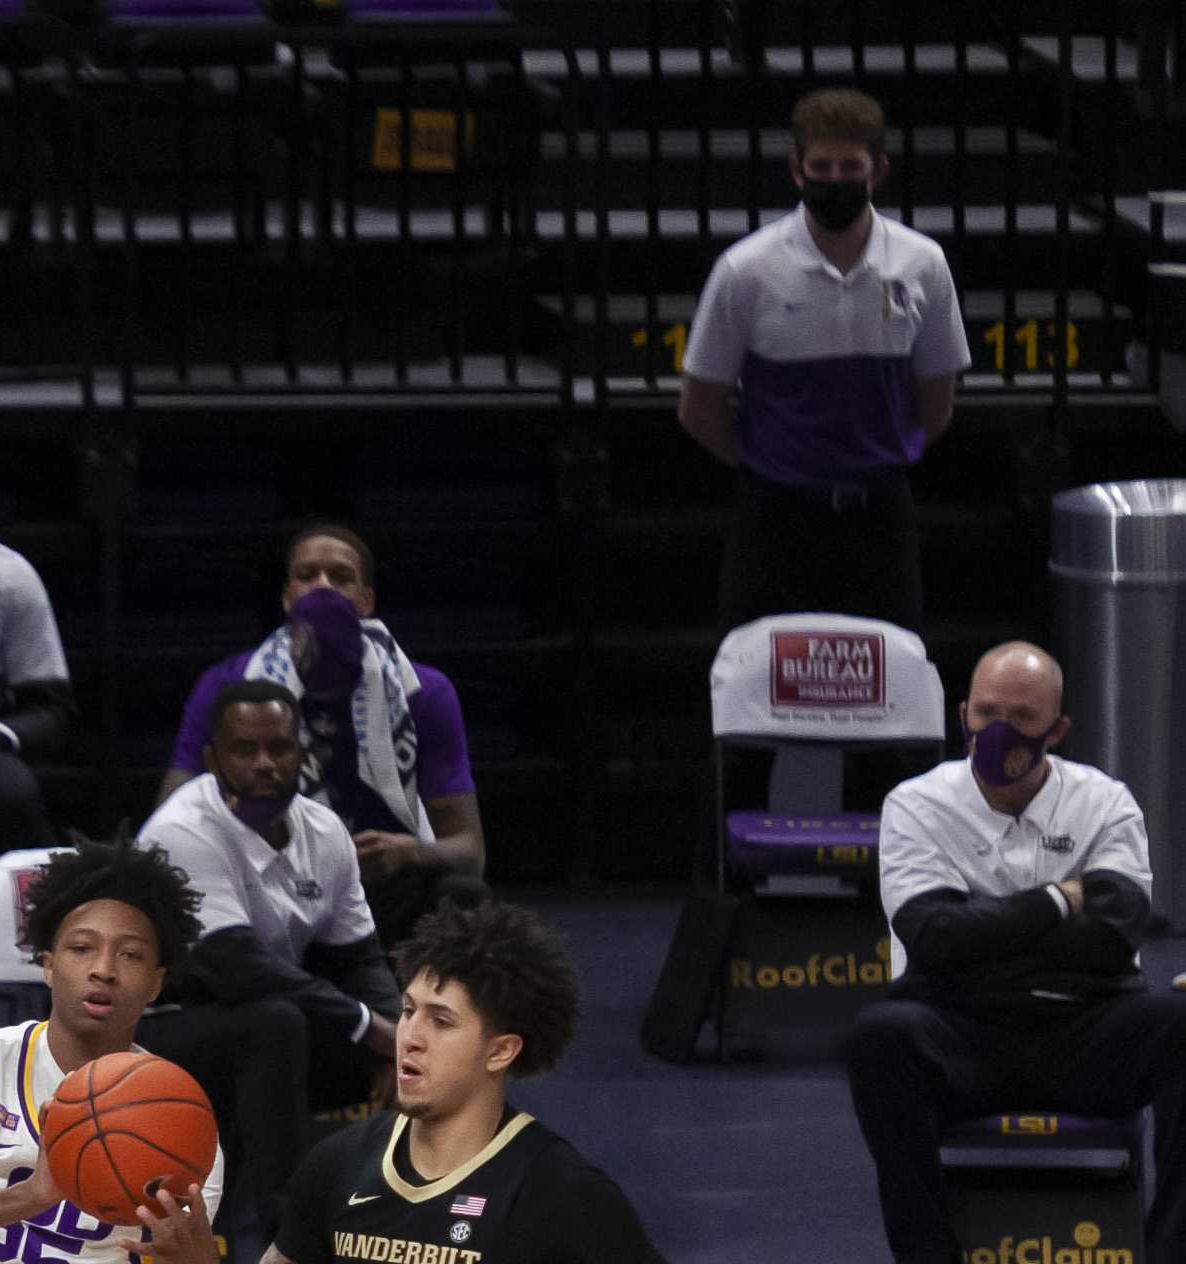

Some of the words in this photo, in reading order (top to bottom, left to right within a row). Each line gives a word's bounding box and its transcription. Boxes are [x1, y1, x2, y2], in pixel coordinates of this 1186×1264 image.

[808, 638, 872, 661] FARM
[782, 657, 874, 682] BUREAU
[1001, 1115, 1058, 1135] LSU
